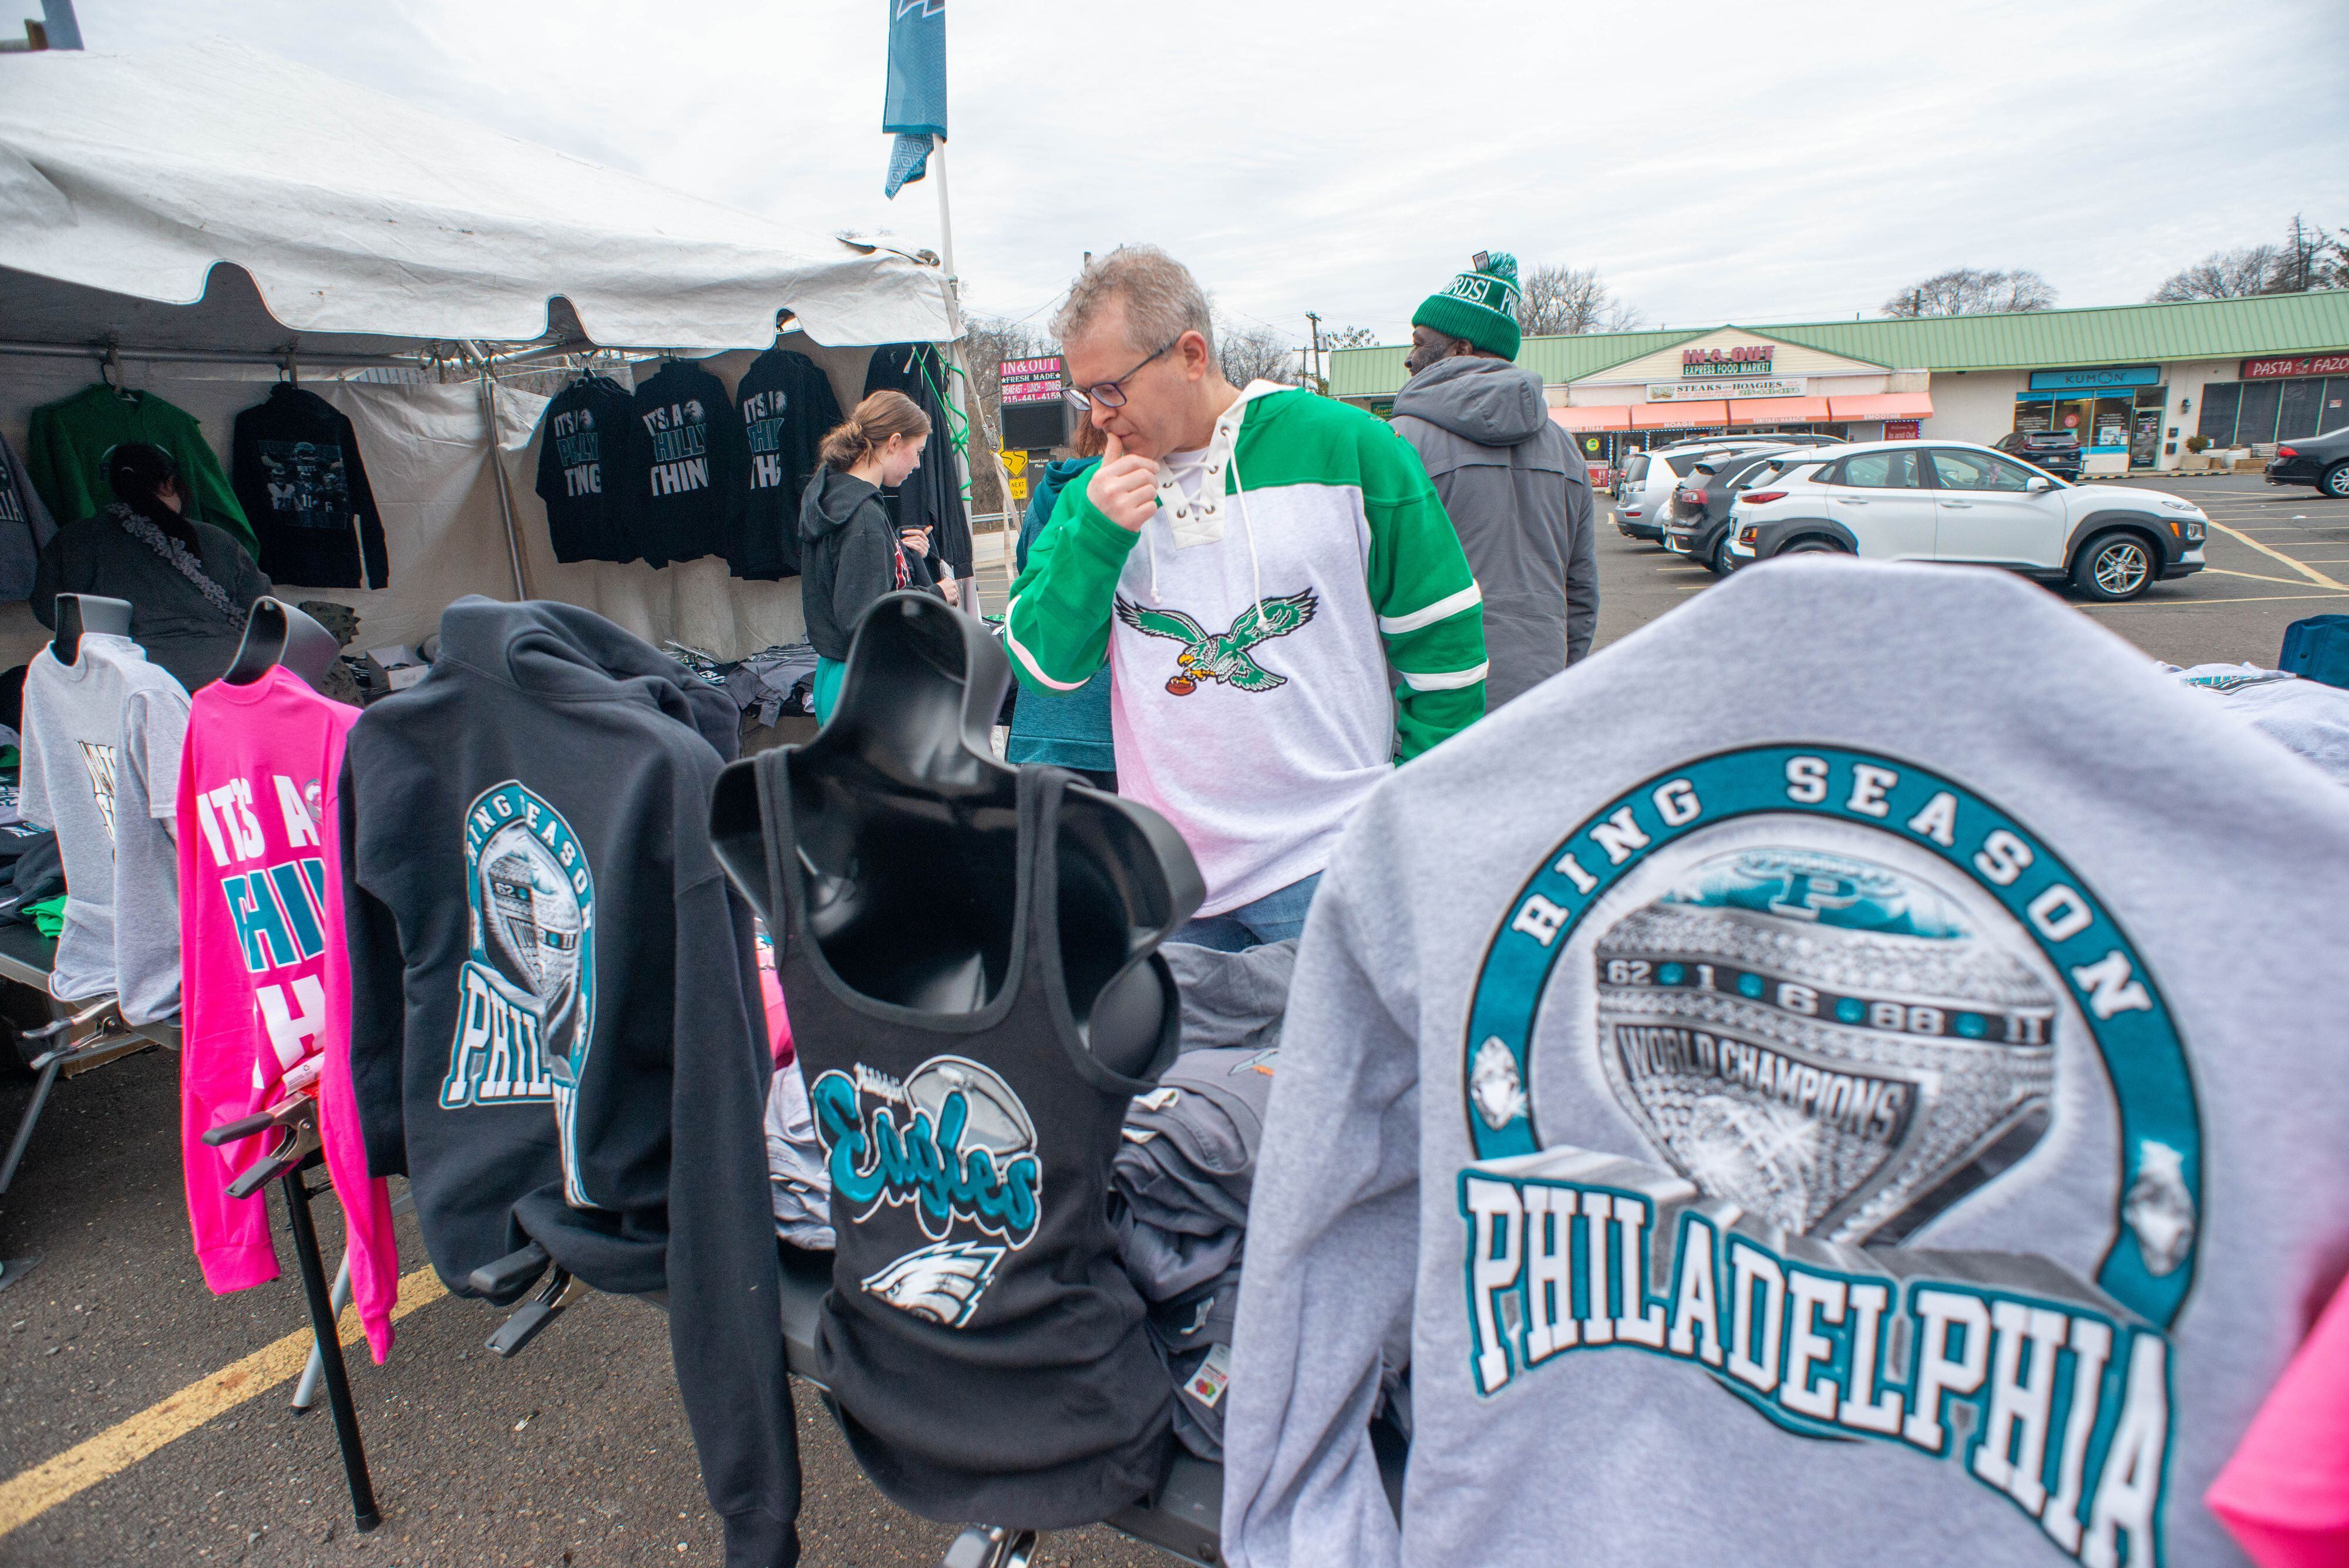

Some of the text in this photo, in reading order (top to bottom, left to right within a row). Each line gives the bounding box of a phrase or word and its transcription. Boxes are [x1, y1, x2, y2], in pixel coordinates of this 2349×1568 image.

[1683, 345, 1775, 364] IN & OUT
[1006, 372, 1055, 383] FRESH MADE
[1685, 362, 1770, 375] EXPRESS FOOD MARKET
[2065, 372, 2123, 385] KUMON
[2253, 361, 2293, 375] PASTA
[1027, 383, 1041, 393] LUNCH
[1045, 381, 1061, 391] DINNER
[672, 403, 684, 426] A
[196, 778, 265, 866] IT'S
[272, 775, 320, 848] A
[493, 882, 517, 899] 62
[1512, 756, 2152, 1019] RING SEASON
[1768, 872, 1863, 922] P
[1607, 959, 2044, 1044] 62 1 6 88 11
[1617, 1026, 1909, 1145] WORLD CHAMPIONS
[812, 1070, 1042, 1248] Eagles
[1460, 1172, 2172, 1568] PHILADELPHIA
